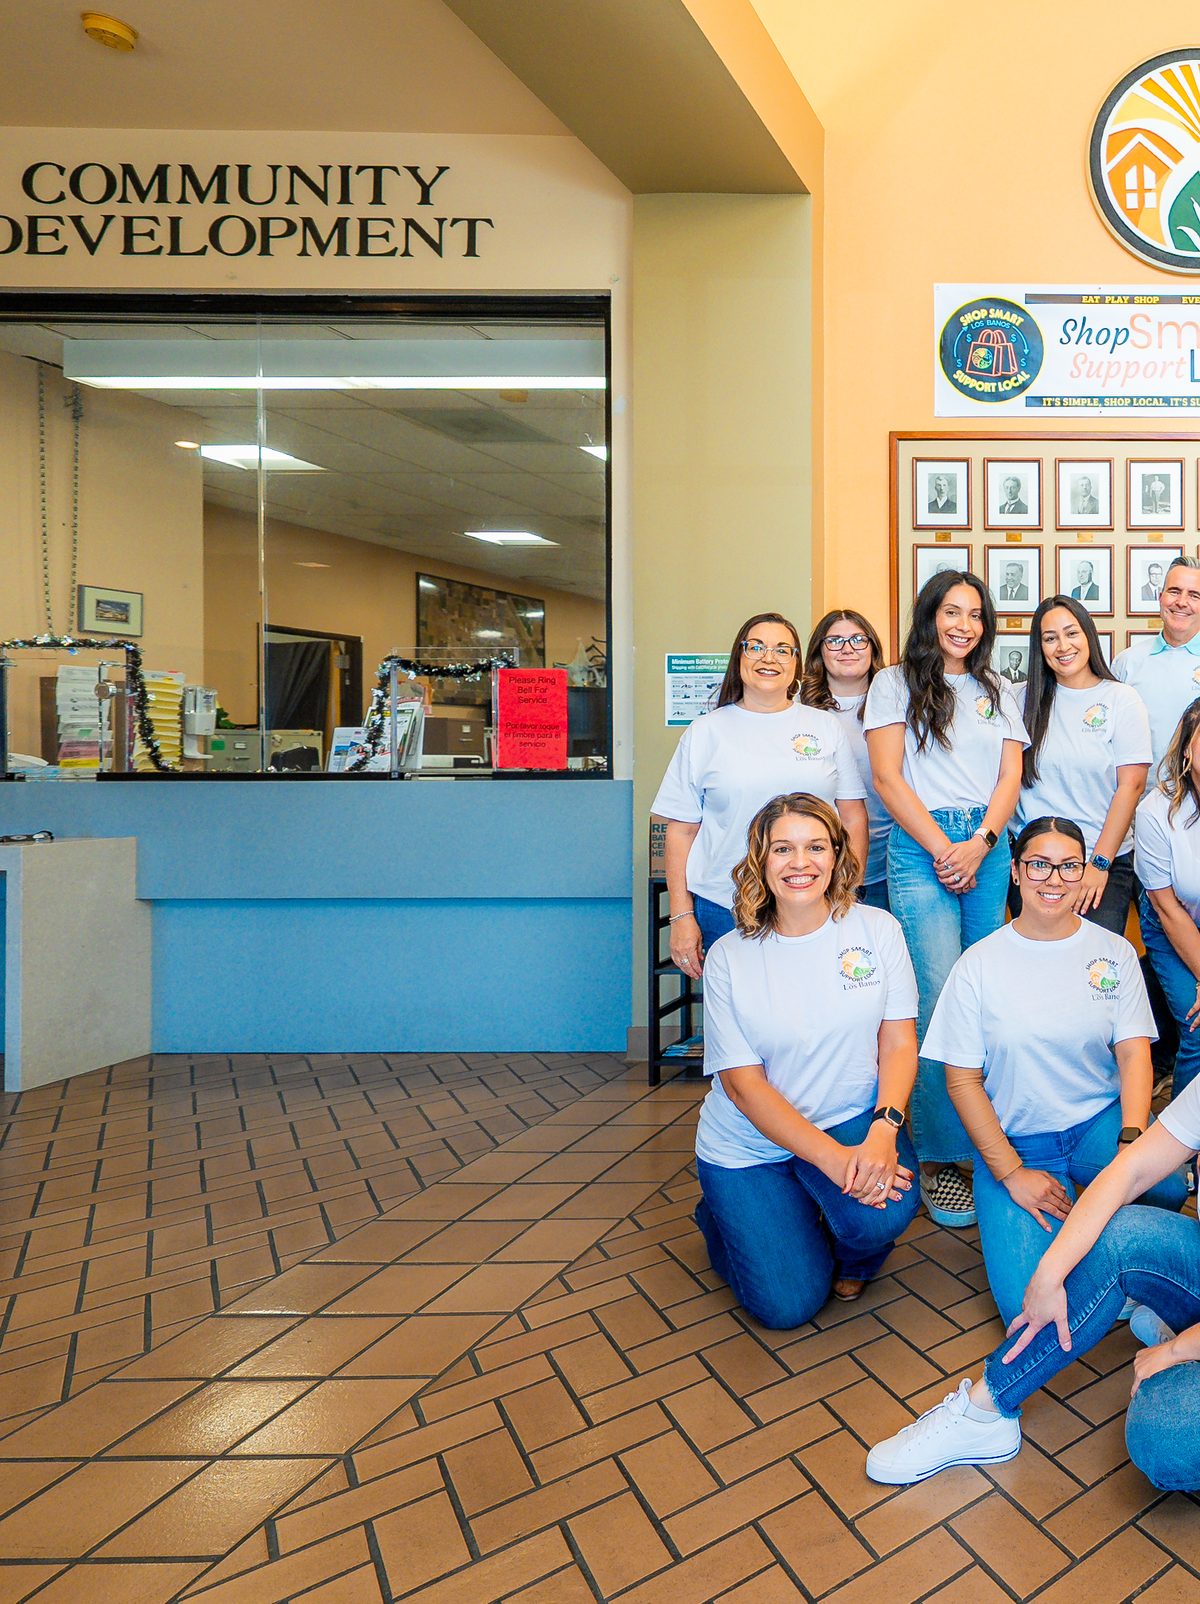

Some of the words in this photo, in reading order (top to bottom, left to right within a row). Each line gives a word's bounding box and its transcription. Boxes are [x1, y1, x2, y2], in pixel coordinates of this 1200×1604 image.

[21, 162, 451, 206] COMMUNITY
[1082, 295, 1100, 304] EAT
[1105, 295, 1129, 304] PLAY
[1134, 295, 1159, 304] SHOP
[960, 308, 988, 326] SHOP
[989, 308, 1024, 326] SMART
[970, 320, 984, 330] LOS
[1059, 316, 1130, 354] Shop
[1069, 352, 1186, 388] Support
[953, 370, 997, 392] SUPPORT
[998, 371, 1030, 392] LOCAL
[1042, 398, 1061, 407] IT'S
[1062, 398, 1102, 408] SIMPLE,
[1103, 398, 1132, 407] SHOP
[1169, 398, 1187, 407] IT'S
[509, 675, 536, 684] Please
[538, 676, 556, 685] Ring
[517, 686, 532, 694] Bell
[534, 686, 548, 694] For
[518, 696, 547, 704] Service
[652, 824, 668, 833] RE
[838, 948, 849, 959] SHOP
[850, 946, 872, 957] SMART
[1085, 958, 1098, 970] SHOP
[1099, 957, 1118, 967] SMART
[840, 970, 863, 982] SUPPORT
[864, 966, 876, 980] LOCAL
[858, 980, 881, 988] Banos
[1088, 981, 1109, 993] SUPPORT
[1104, 993, 1120, 1001] Bano
